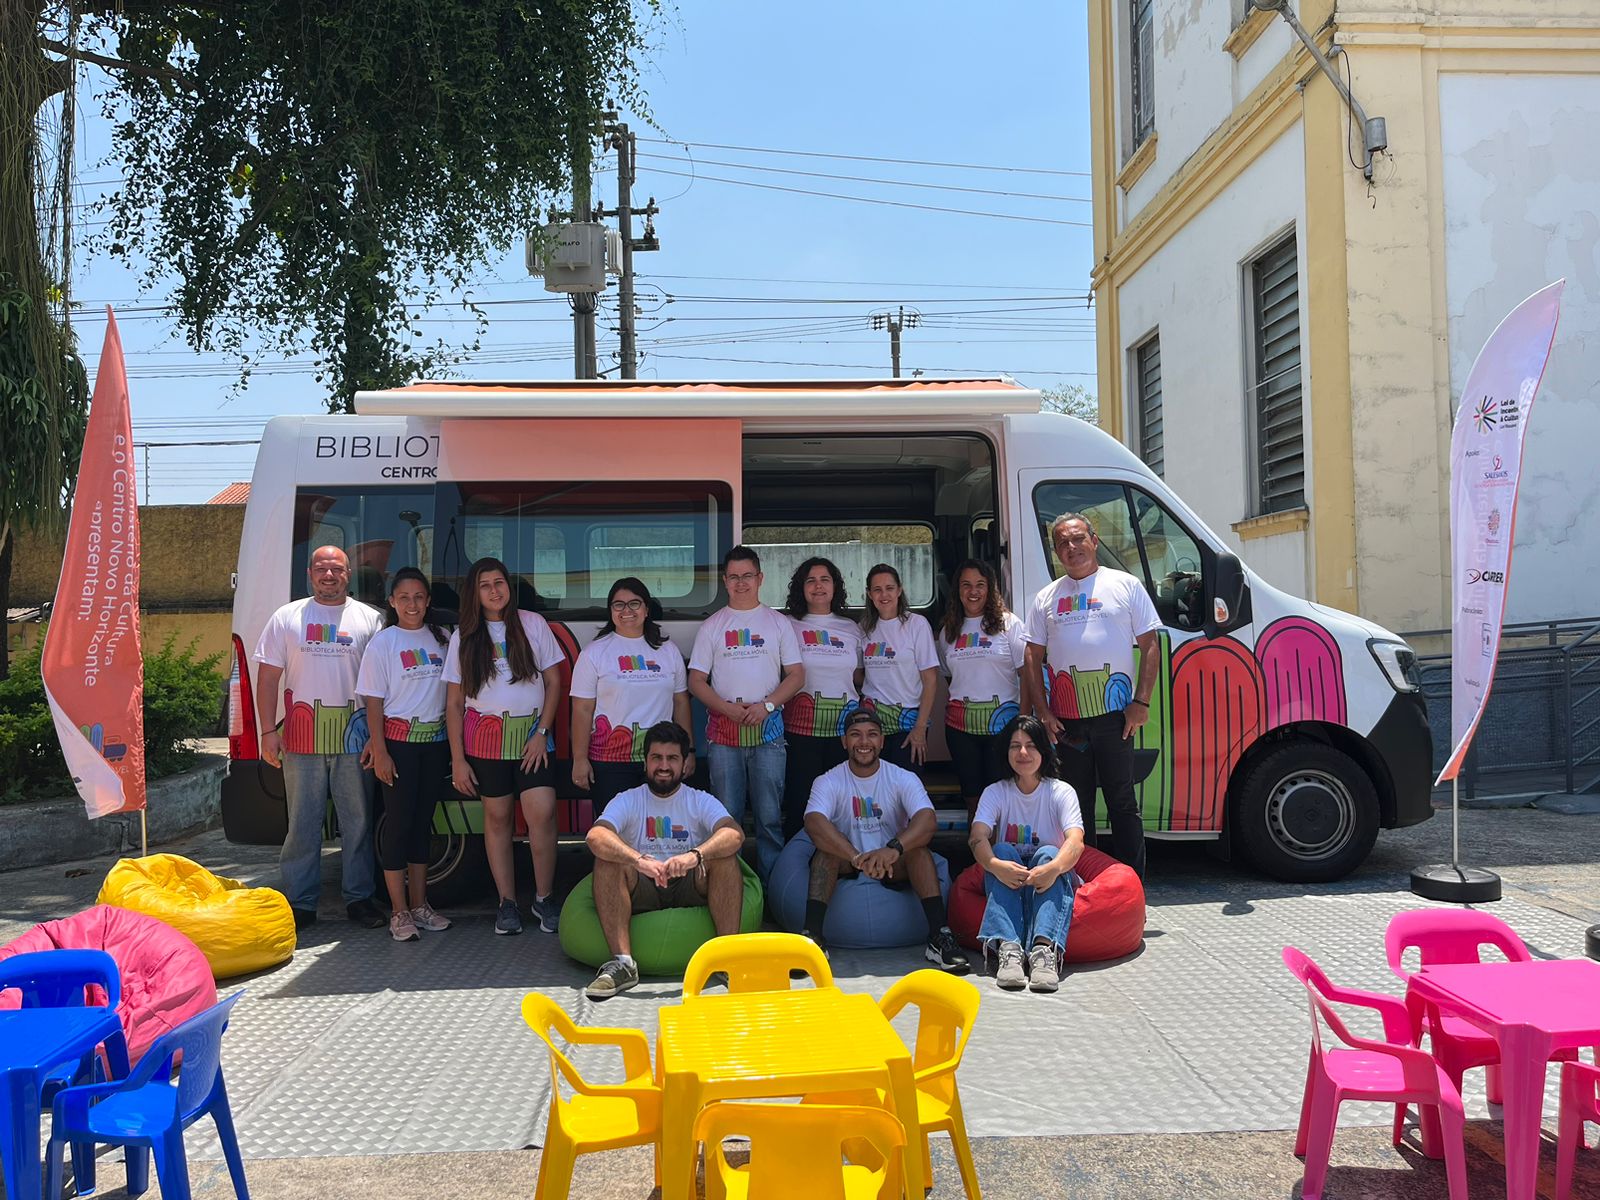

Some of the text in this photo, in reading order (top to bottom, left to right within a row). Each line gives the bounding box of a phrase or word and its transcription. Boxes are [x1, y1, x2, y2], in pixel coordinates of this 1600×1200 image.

[84, 434, 129, 687] e o Centro Novo Horizonte
[123, 573, 134, 596] da
[104, 601, 132, 666] Cultura
